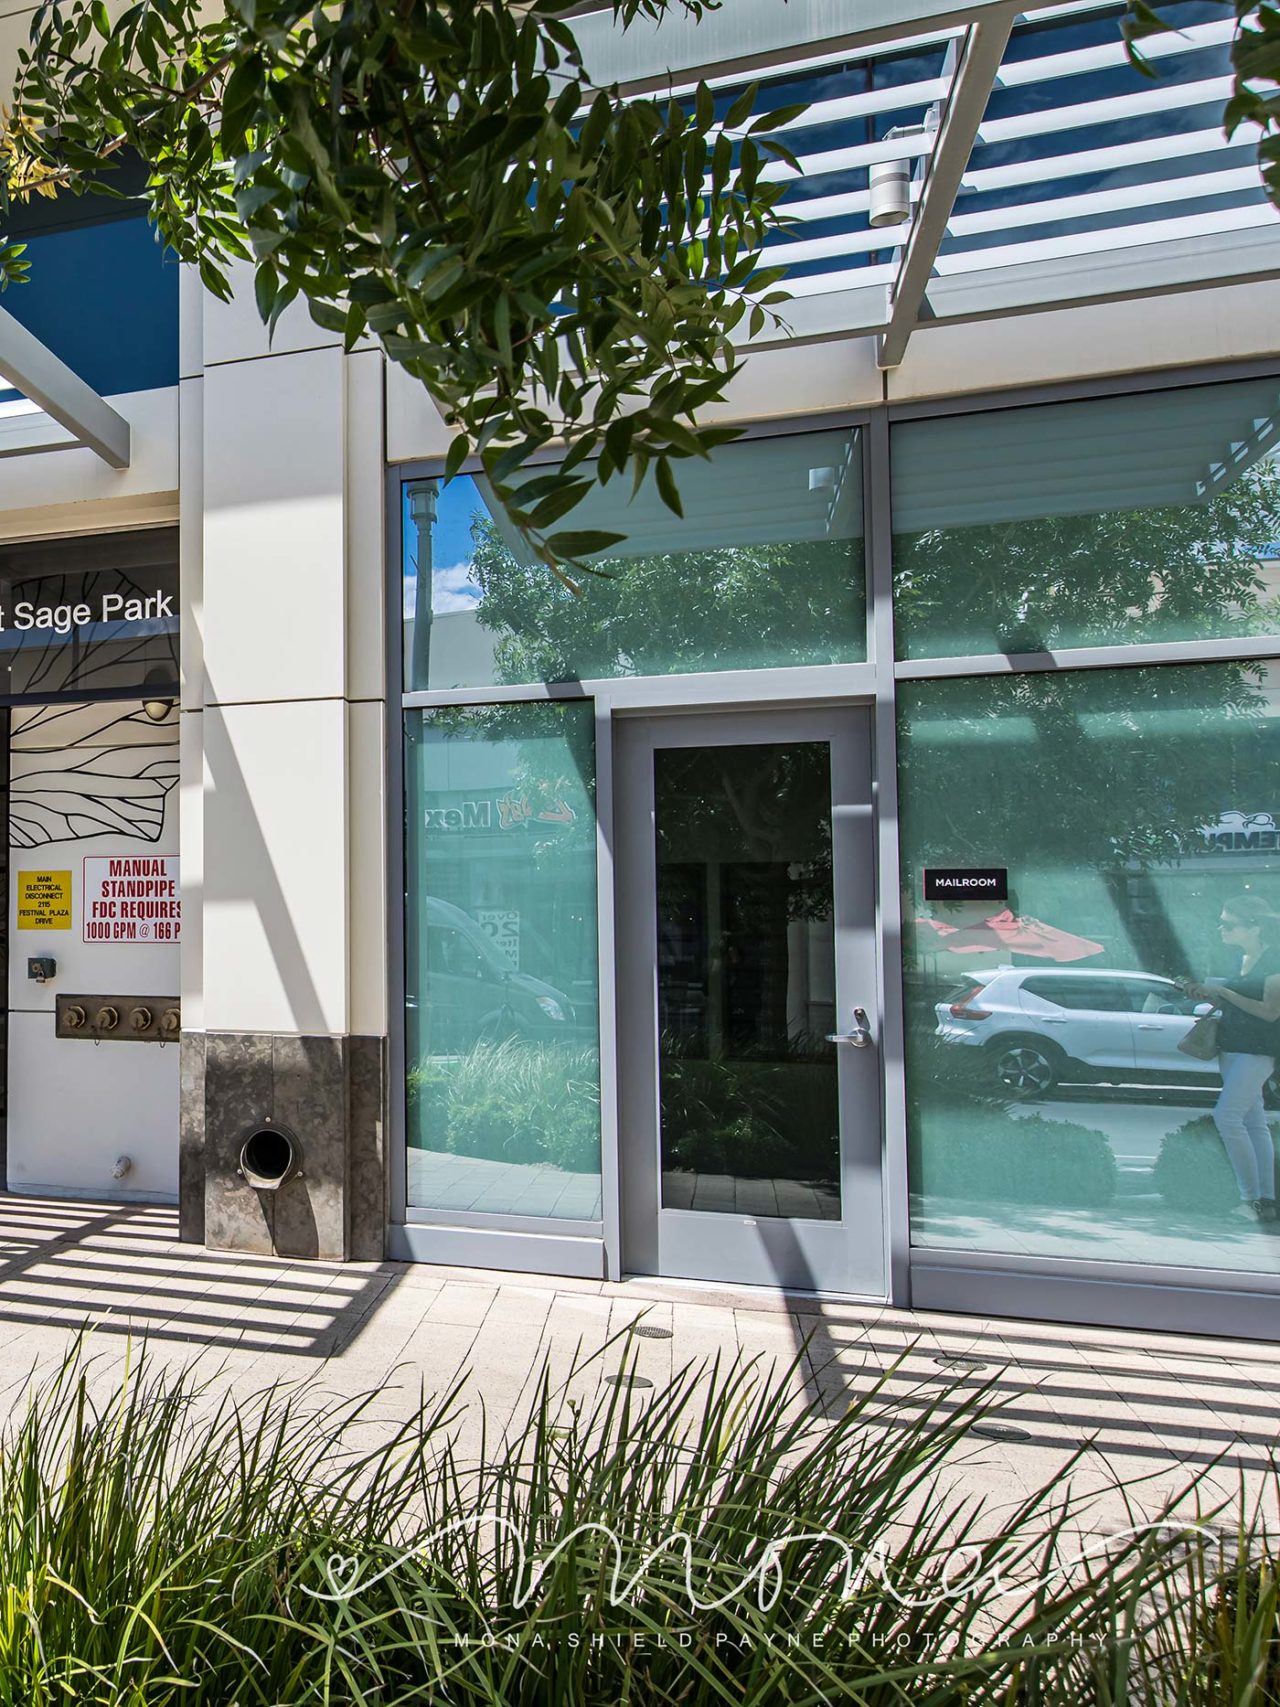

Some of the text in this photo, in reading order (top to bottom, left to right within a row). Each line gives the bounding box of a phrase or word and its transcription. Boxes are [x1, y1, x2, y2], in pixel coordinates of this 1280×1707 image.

[14, 602, 91, 635] Sage
[102, 590, 173, 622] Park
[109, 859, 167, 877] MANUAL
[101, 880, 175, 898] STANDPIPE
[935, 878, 996, 887] MAILROOM
[92, 901, 117, 919] FDC
[35, 917, 54, 925] DRIVE
[86, 922, 111, 939] 1000
[113, 922, 136, 939] GPM
[139, 923, 150, 938] @
[153, 922, 172, 939] 166
